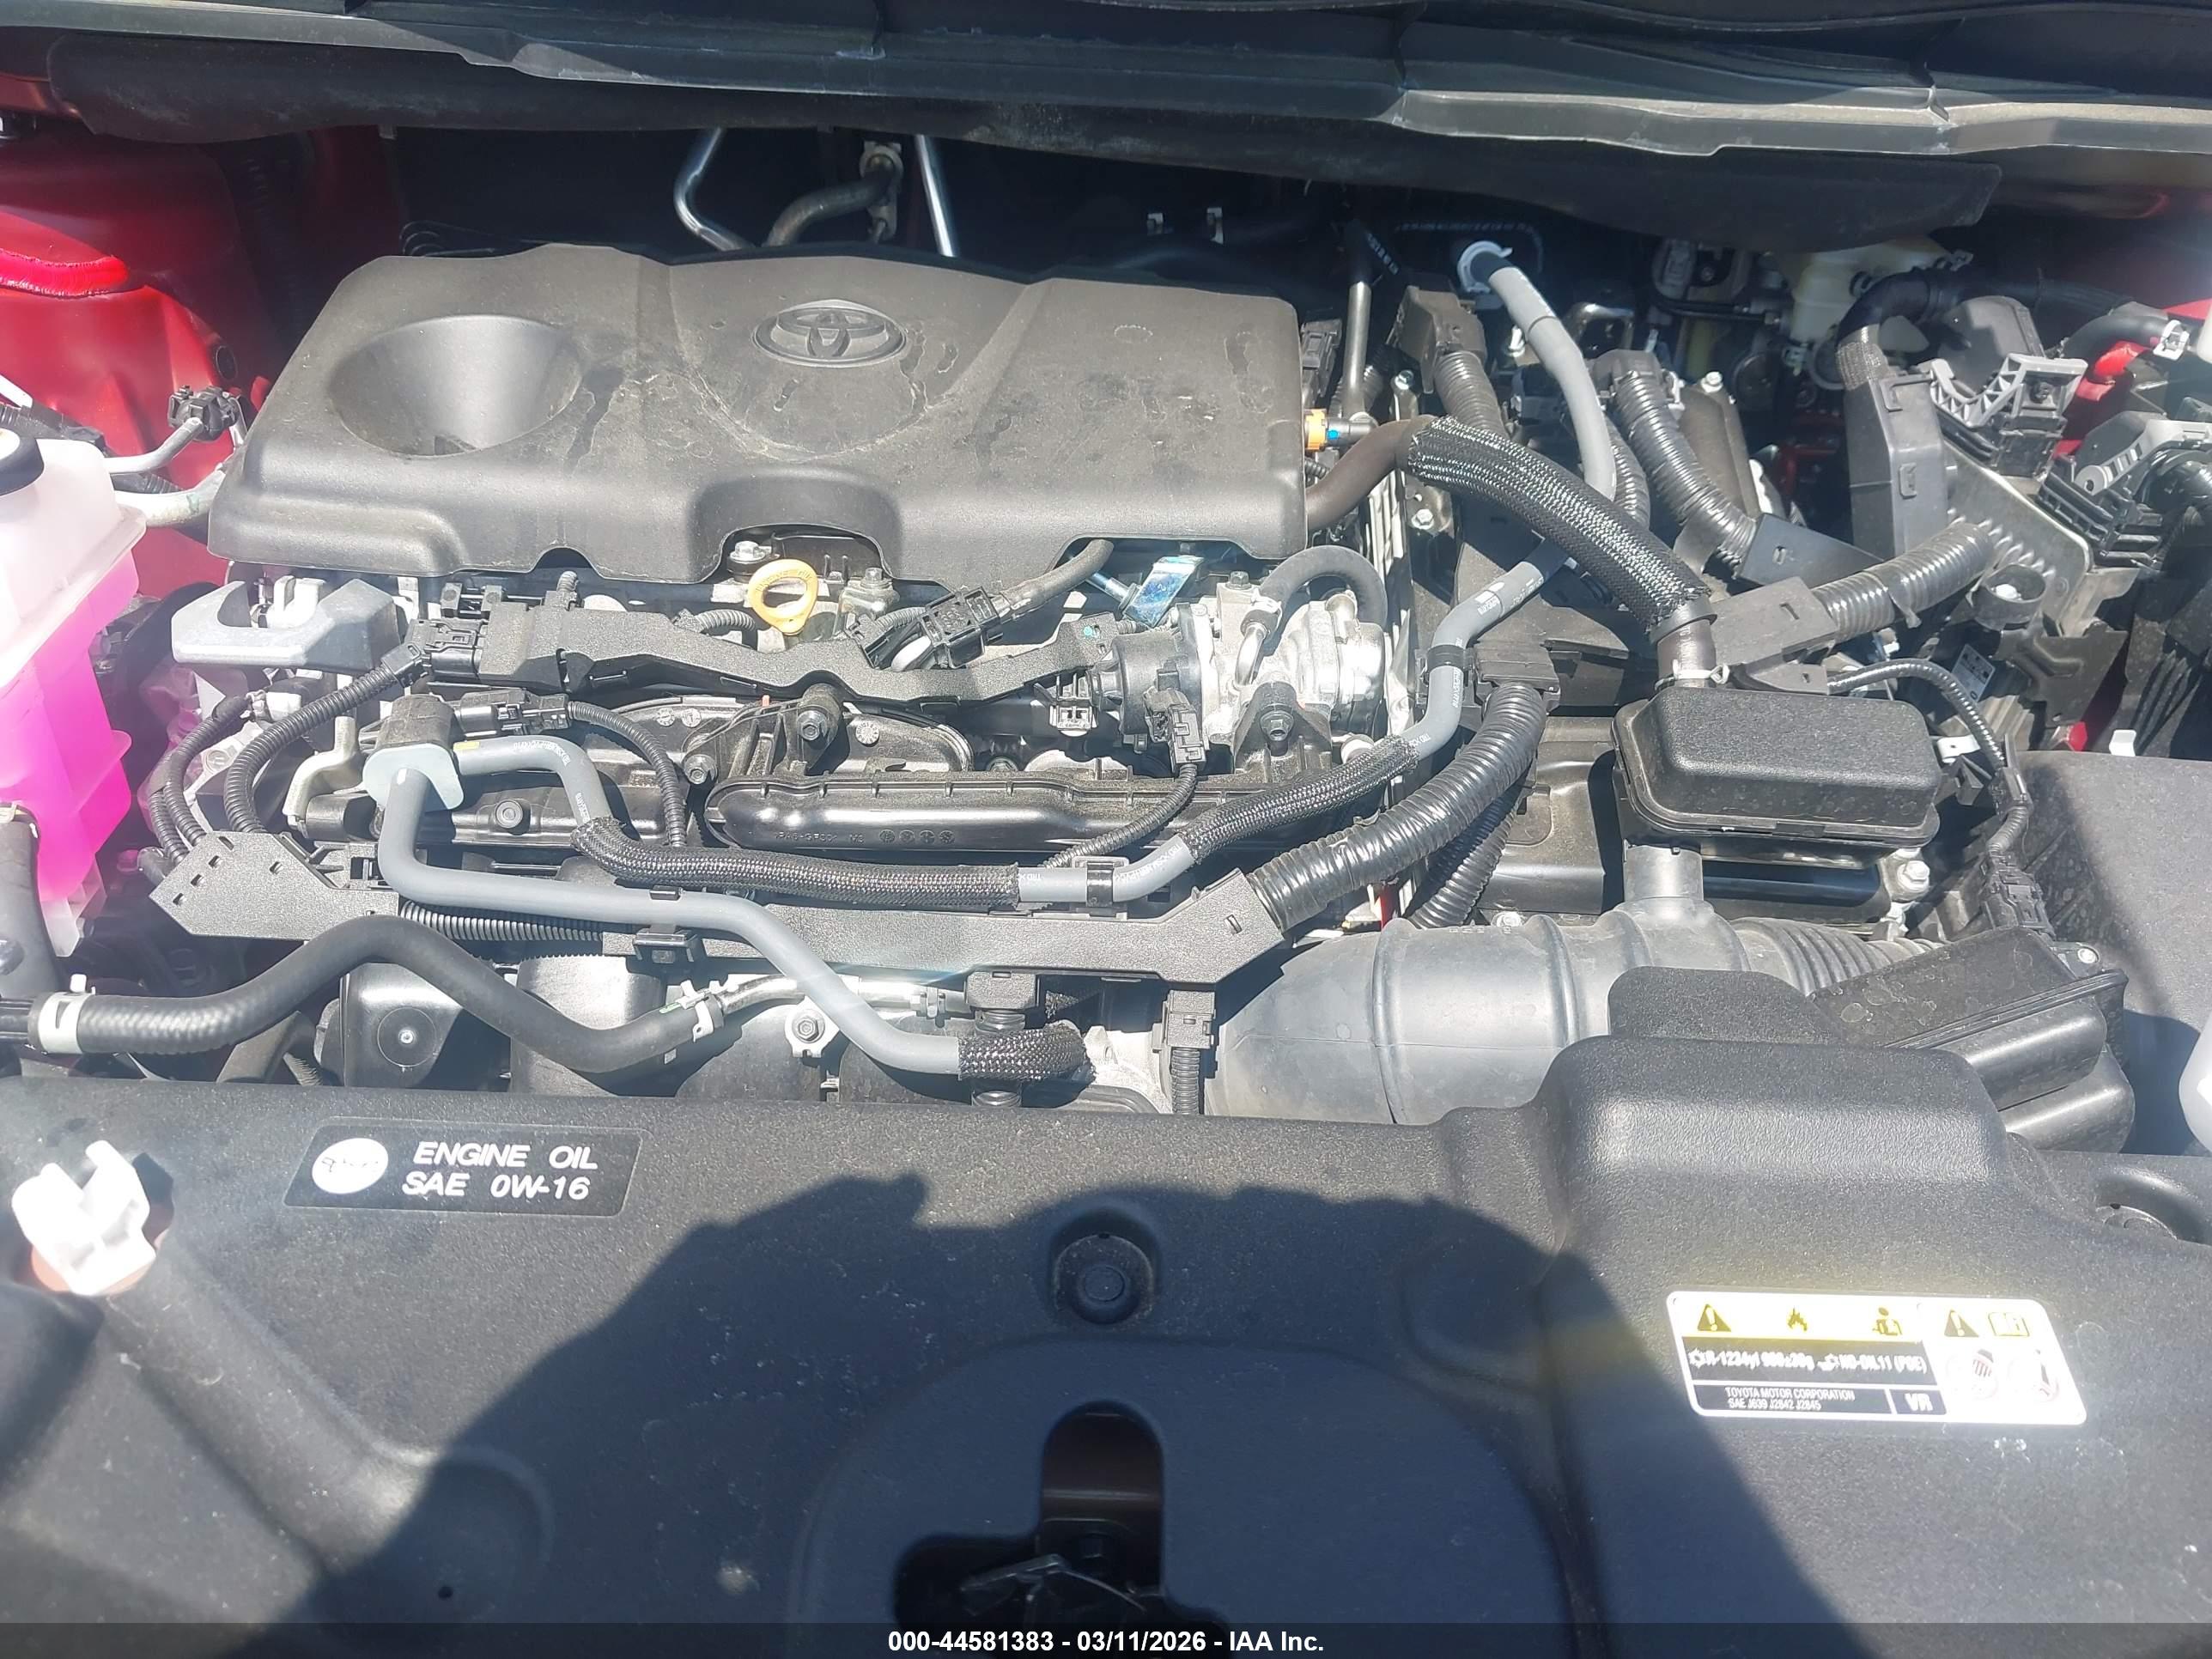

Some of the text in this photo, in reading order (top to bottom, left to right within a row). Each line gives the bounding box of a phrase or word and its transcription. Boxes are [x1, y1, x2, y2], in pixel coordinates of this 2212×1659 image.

[413, 1141, 599, 1170] ENGINE OIL
[402, 1171, 591, 1200] SAE 0W-16
[1724, 1387, 1856, 1401] TOYOTA MOTOR CORPORATION
[1905, 1394, 1933, 1411] VR
[1728, 1398, 1747, 1408] SAE
[1747, 1399, 1768, 1409] J639
